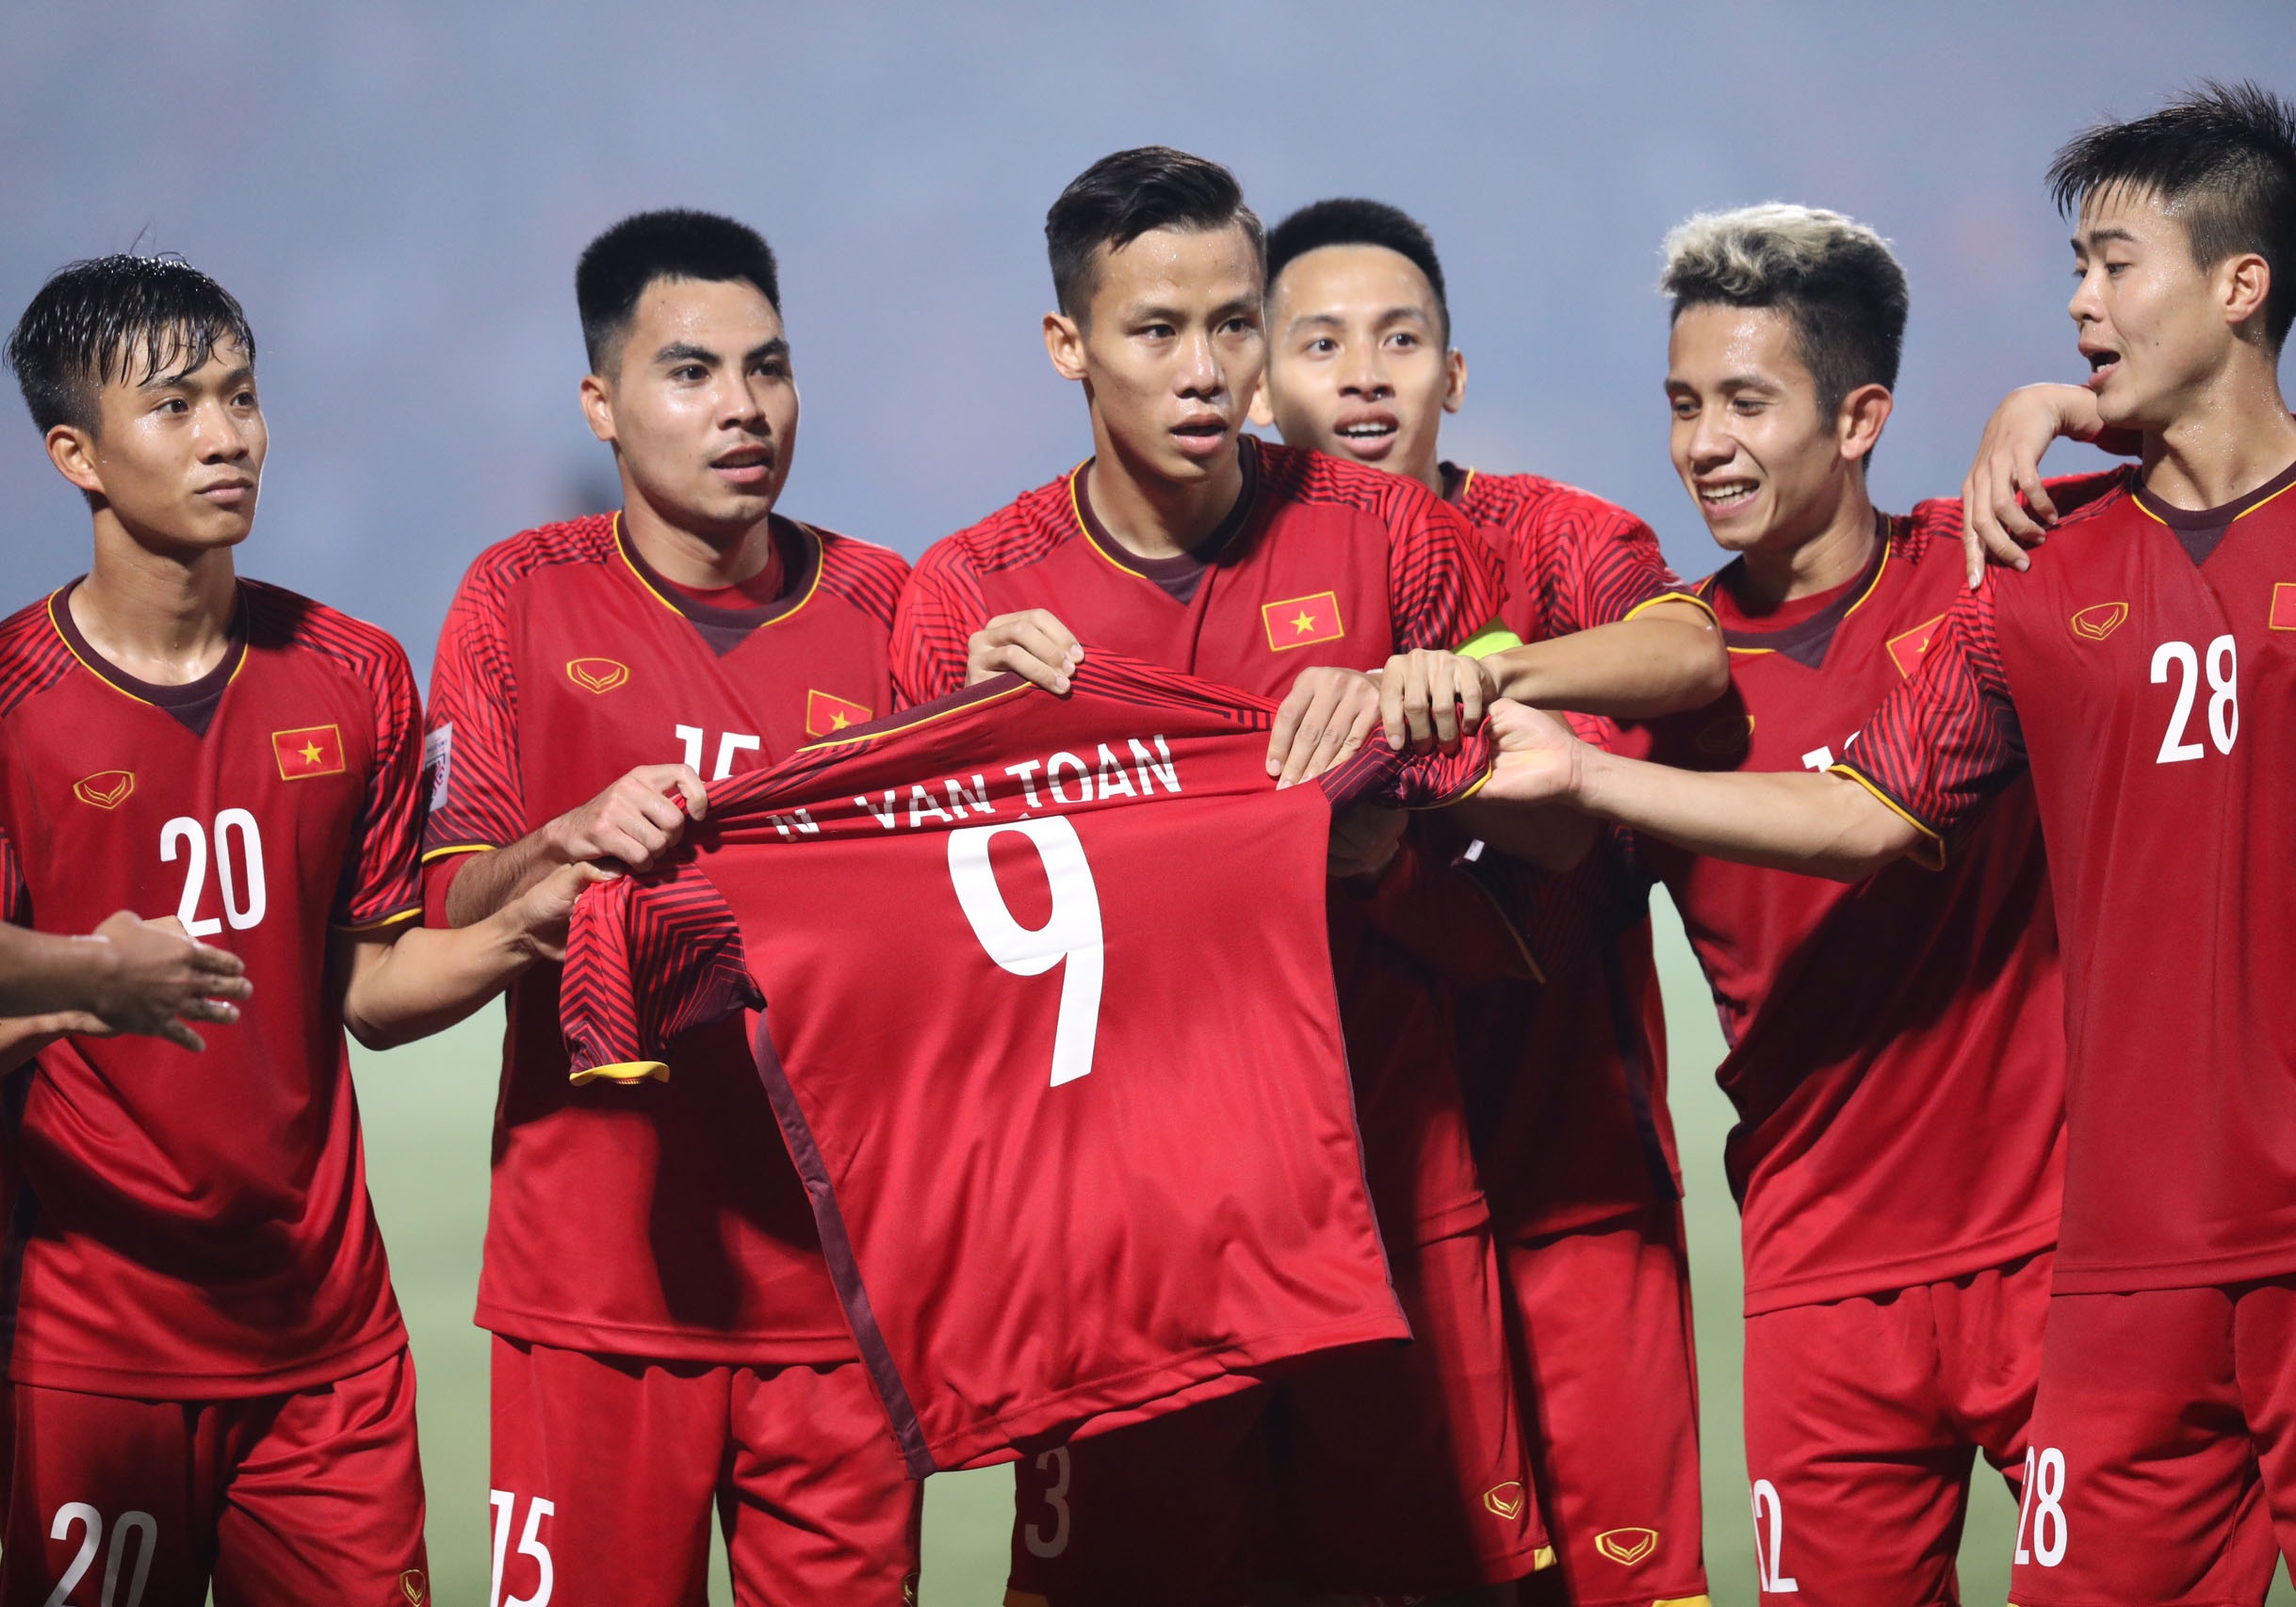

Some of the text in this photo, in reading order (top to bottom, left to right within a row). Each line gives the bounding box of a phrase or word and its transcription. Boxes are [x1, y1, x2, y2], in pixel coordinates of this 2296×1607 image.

[2150, 634, 2239, 764] 28
[854, 773, 996, 830] VAN
[1004, 734, 1182, 808] TOAN
[160, 807, 267, 937] 20
[948, 815, 1104, 1088] 9
[42, 1501, 158, 1607] 20
[489, 1488, 556, 1607] 15
[1024, 1445, 1071, 1558] 3
[2013, 1445, 2068, 1567] 28
